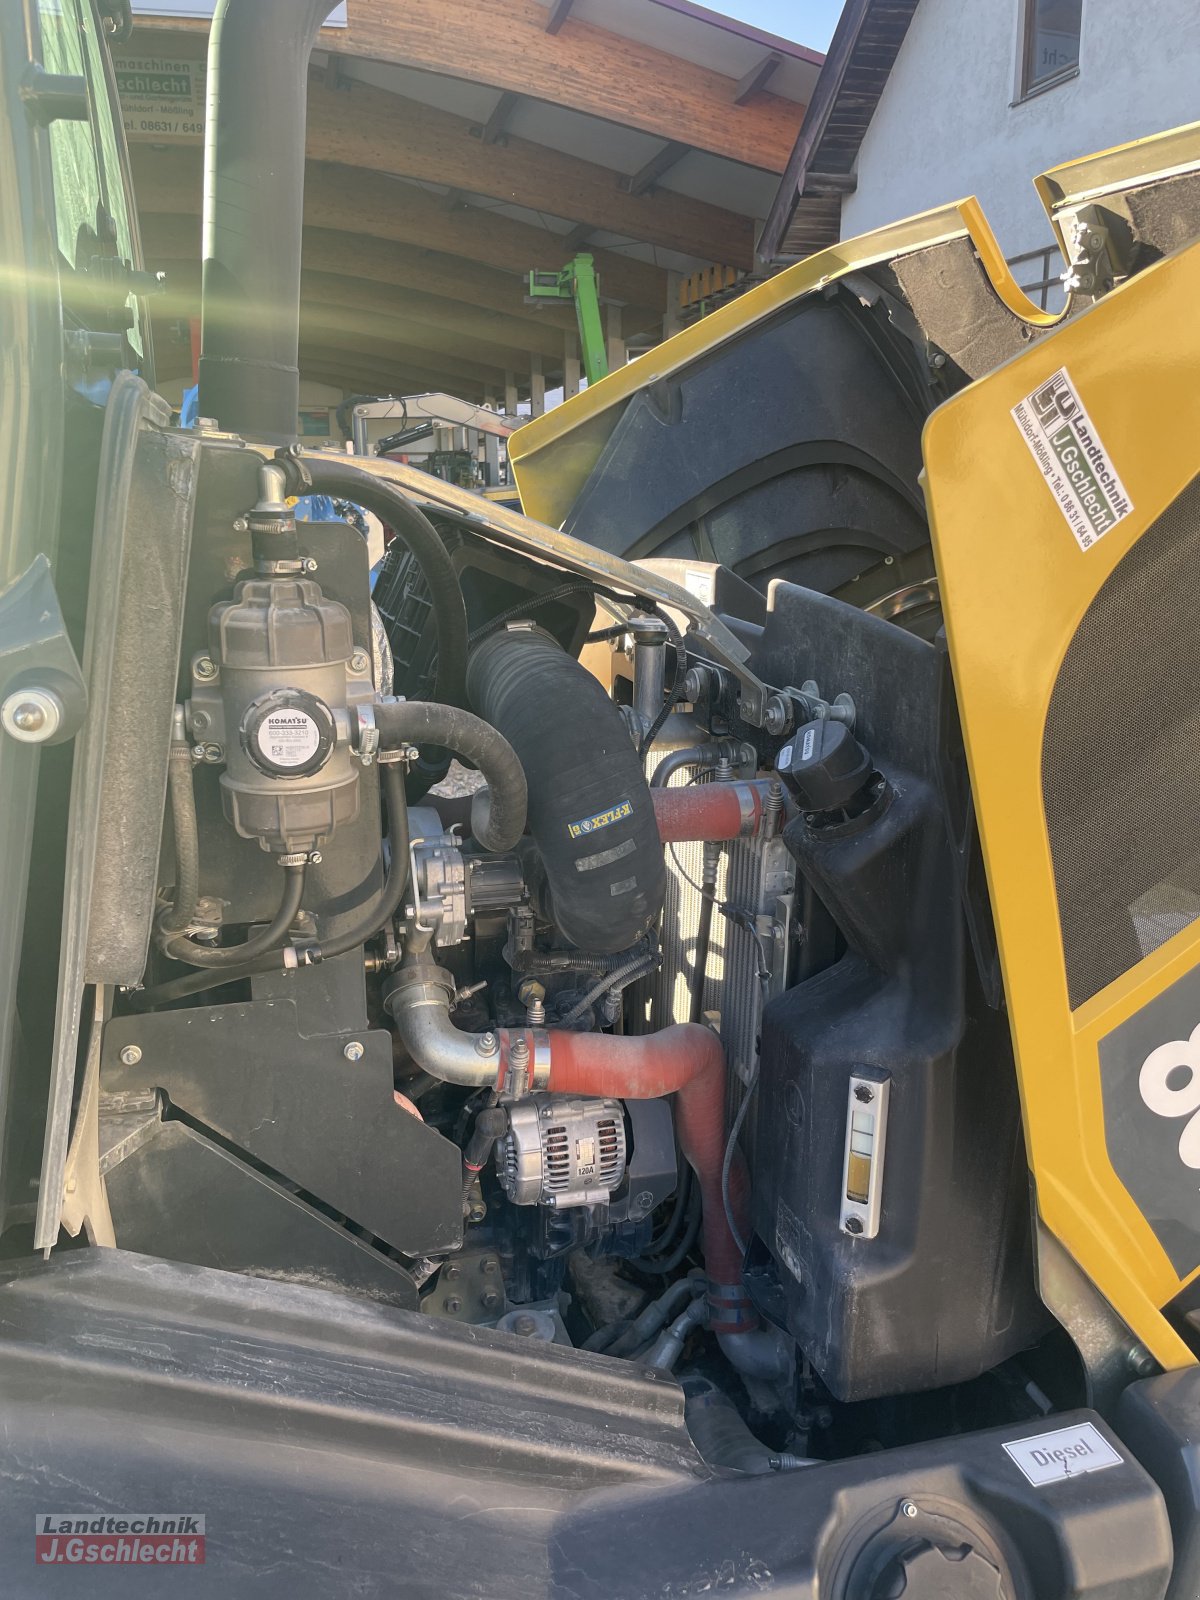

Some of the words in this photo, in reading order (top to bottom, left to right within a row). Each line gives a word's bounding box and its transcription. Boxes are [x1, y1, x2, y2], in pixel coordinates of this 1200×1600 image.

[140, 120, 171, 132] 08631
[1014, 403, 1053, 475] Mühldorf-Mößling
[1071, 415, 1128, 518] Landtechnik
[1052, 435, 1112, 532] J.Gschlecht
[591, 803, 631, 829] K-FLEX
[578, 1167, 594, 1176] 120A
[1030, 1438, 1094, 1467] Diesel
